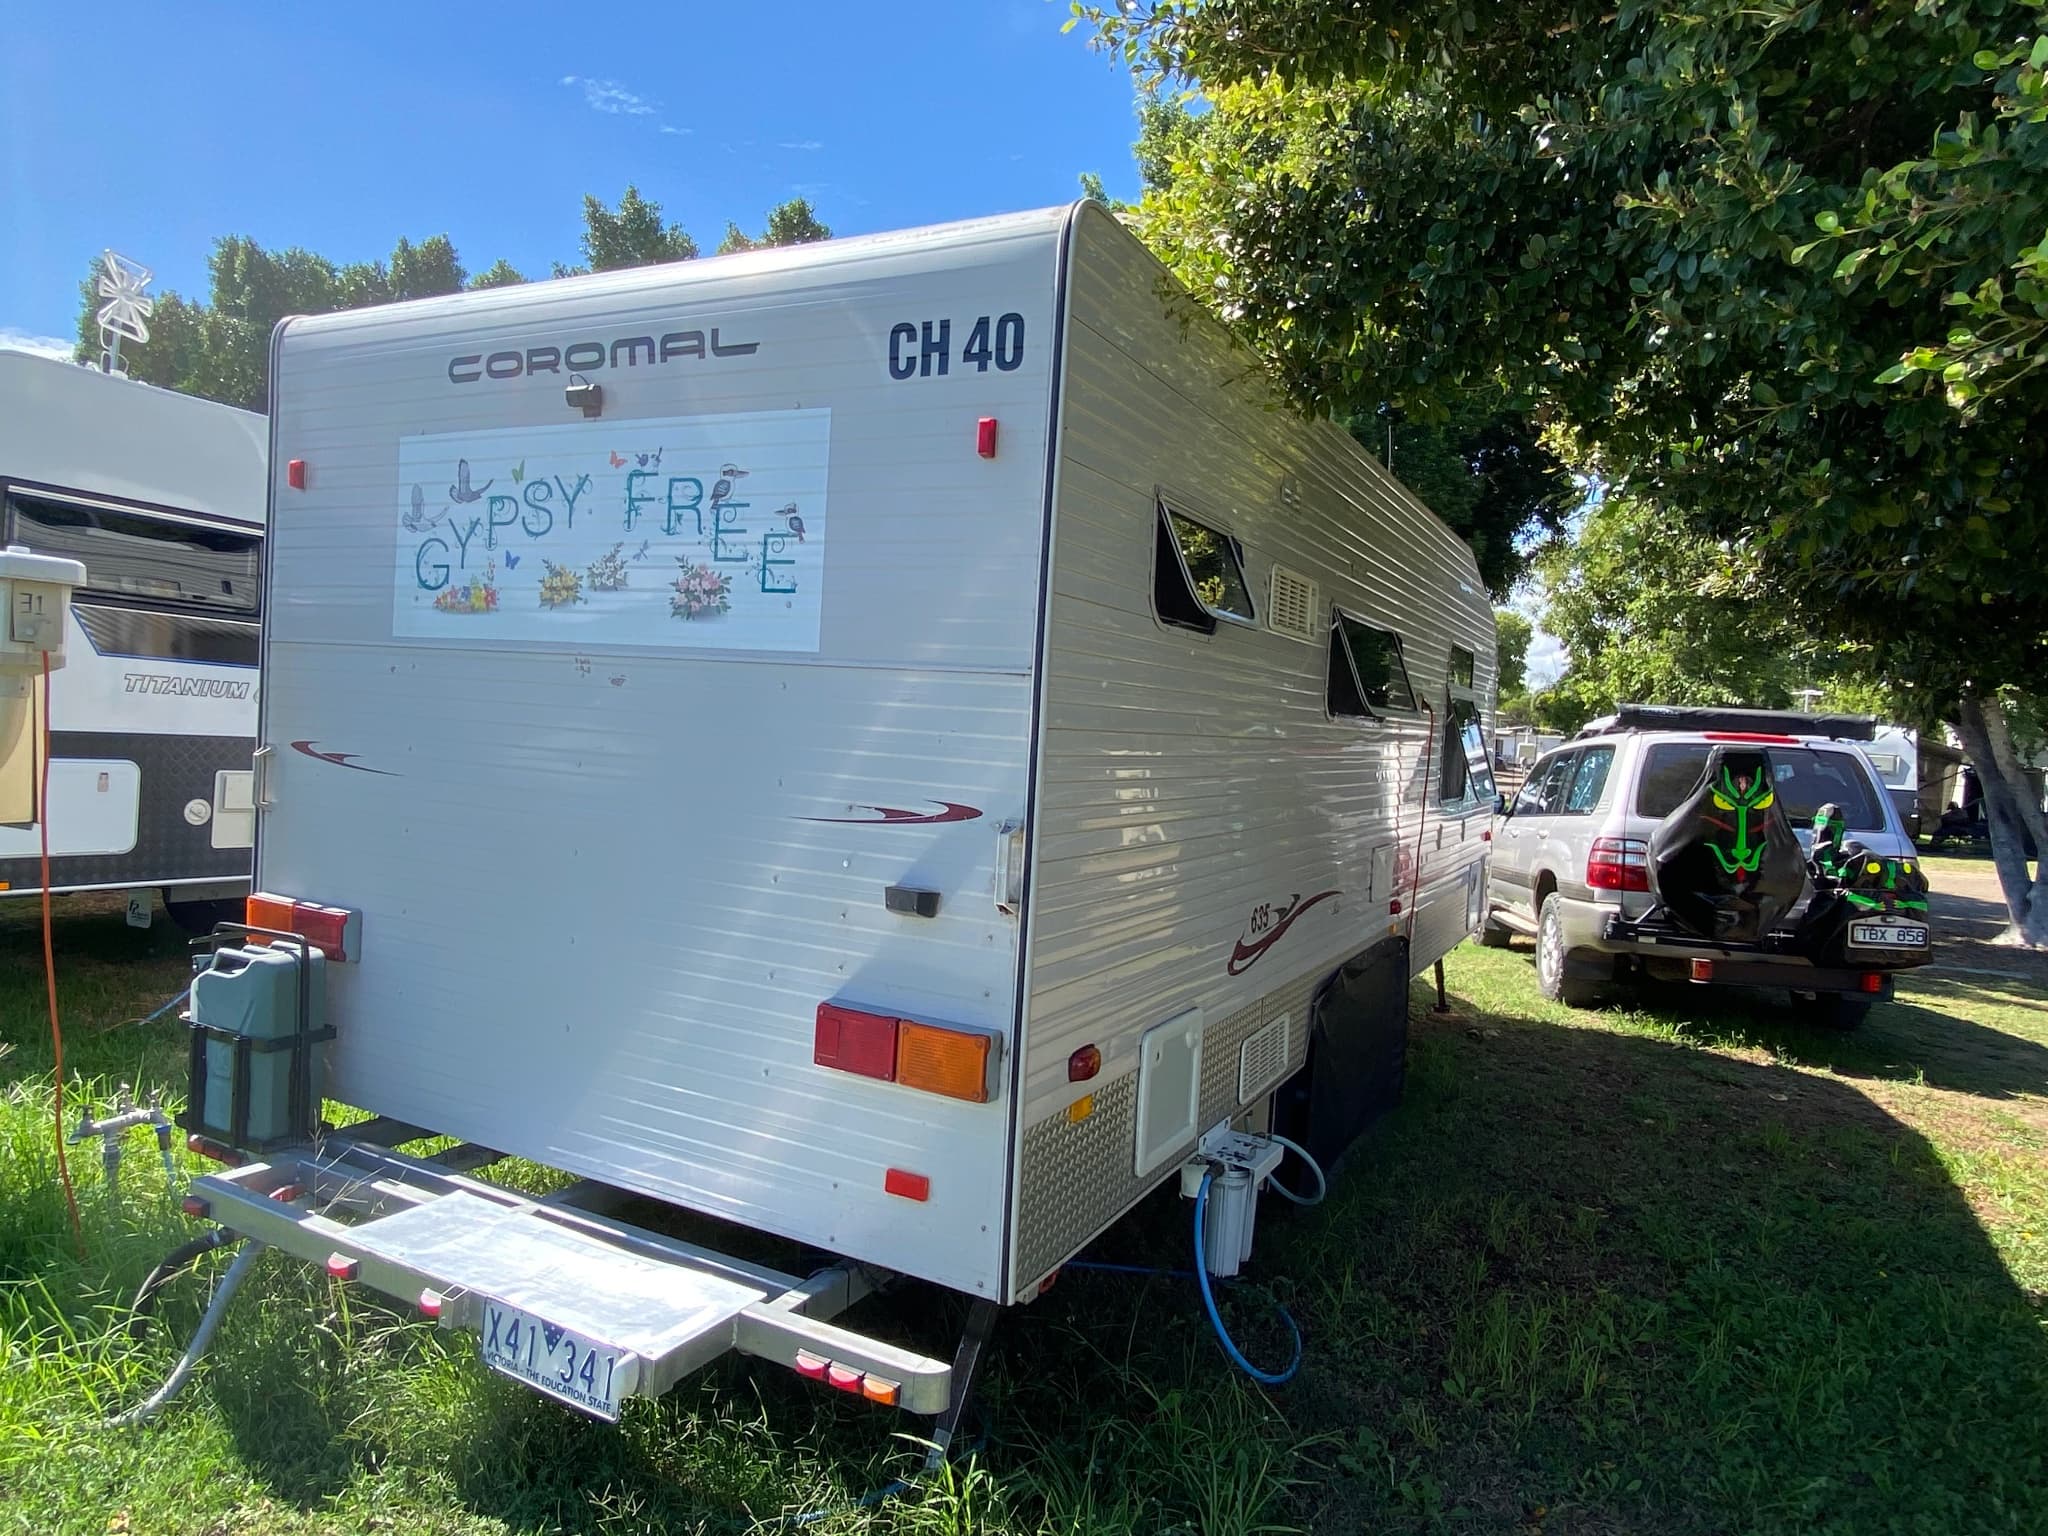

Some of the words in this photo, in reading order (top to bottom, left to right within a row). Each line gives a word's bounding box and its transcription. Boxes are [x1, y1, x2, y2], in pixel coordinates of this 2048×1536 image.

[447, 327, 760, 384] COROMAL
[888, 319, 949, 381] CH
[962, 311, 1025, 372] 40
[415, 472, 592, 592] GYPSY
[623, 466, 798, 594] FREE
[18, 592, 46, 615] 31
[124, 673, 250, 700] TITANIUM
[1250, 903, 1271, 934] 635
[1860, 928, 1888, 941] TBX
[487, 1307, 536, 1367] X41
[559, 1339, 615, 1401] 341
[487, 1350, 519, 1373] VICTORIA
[525, 1366, 541, 1383] THE
[541, 1375, 587, 1403] EDUCATION
[588, 1392, 612, 1413] STATE
